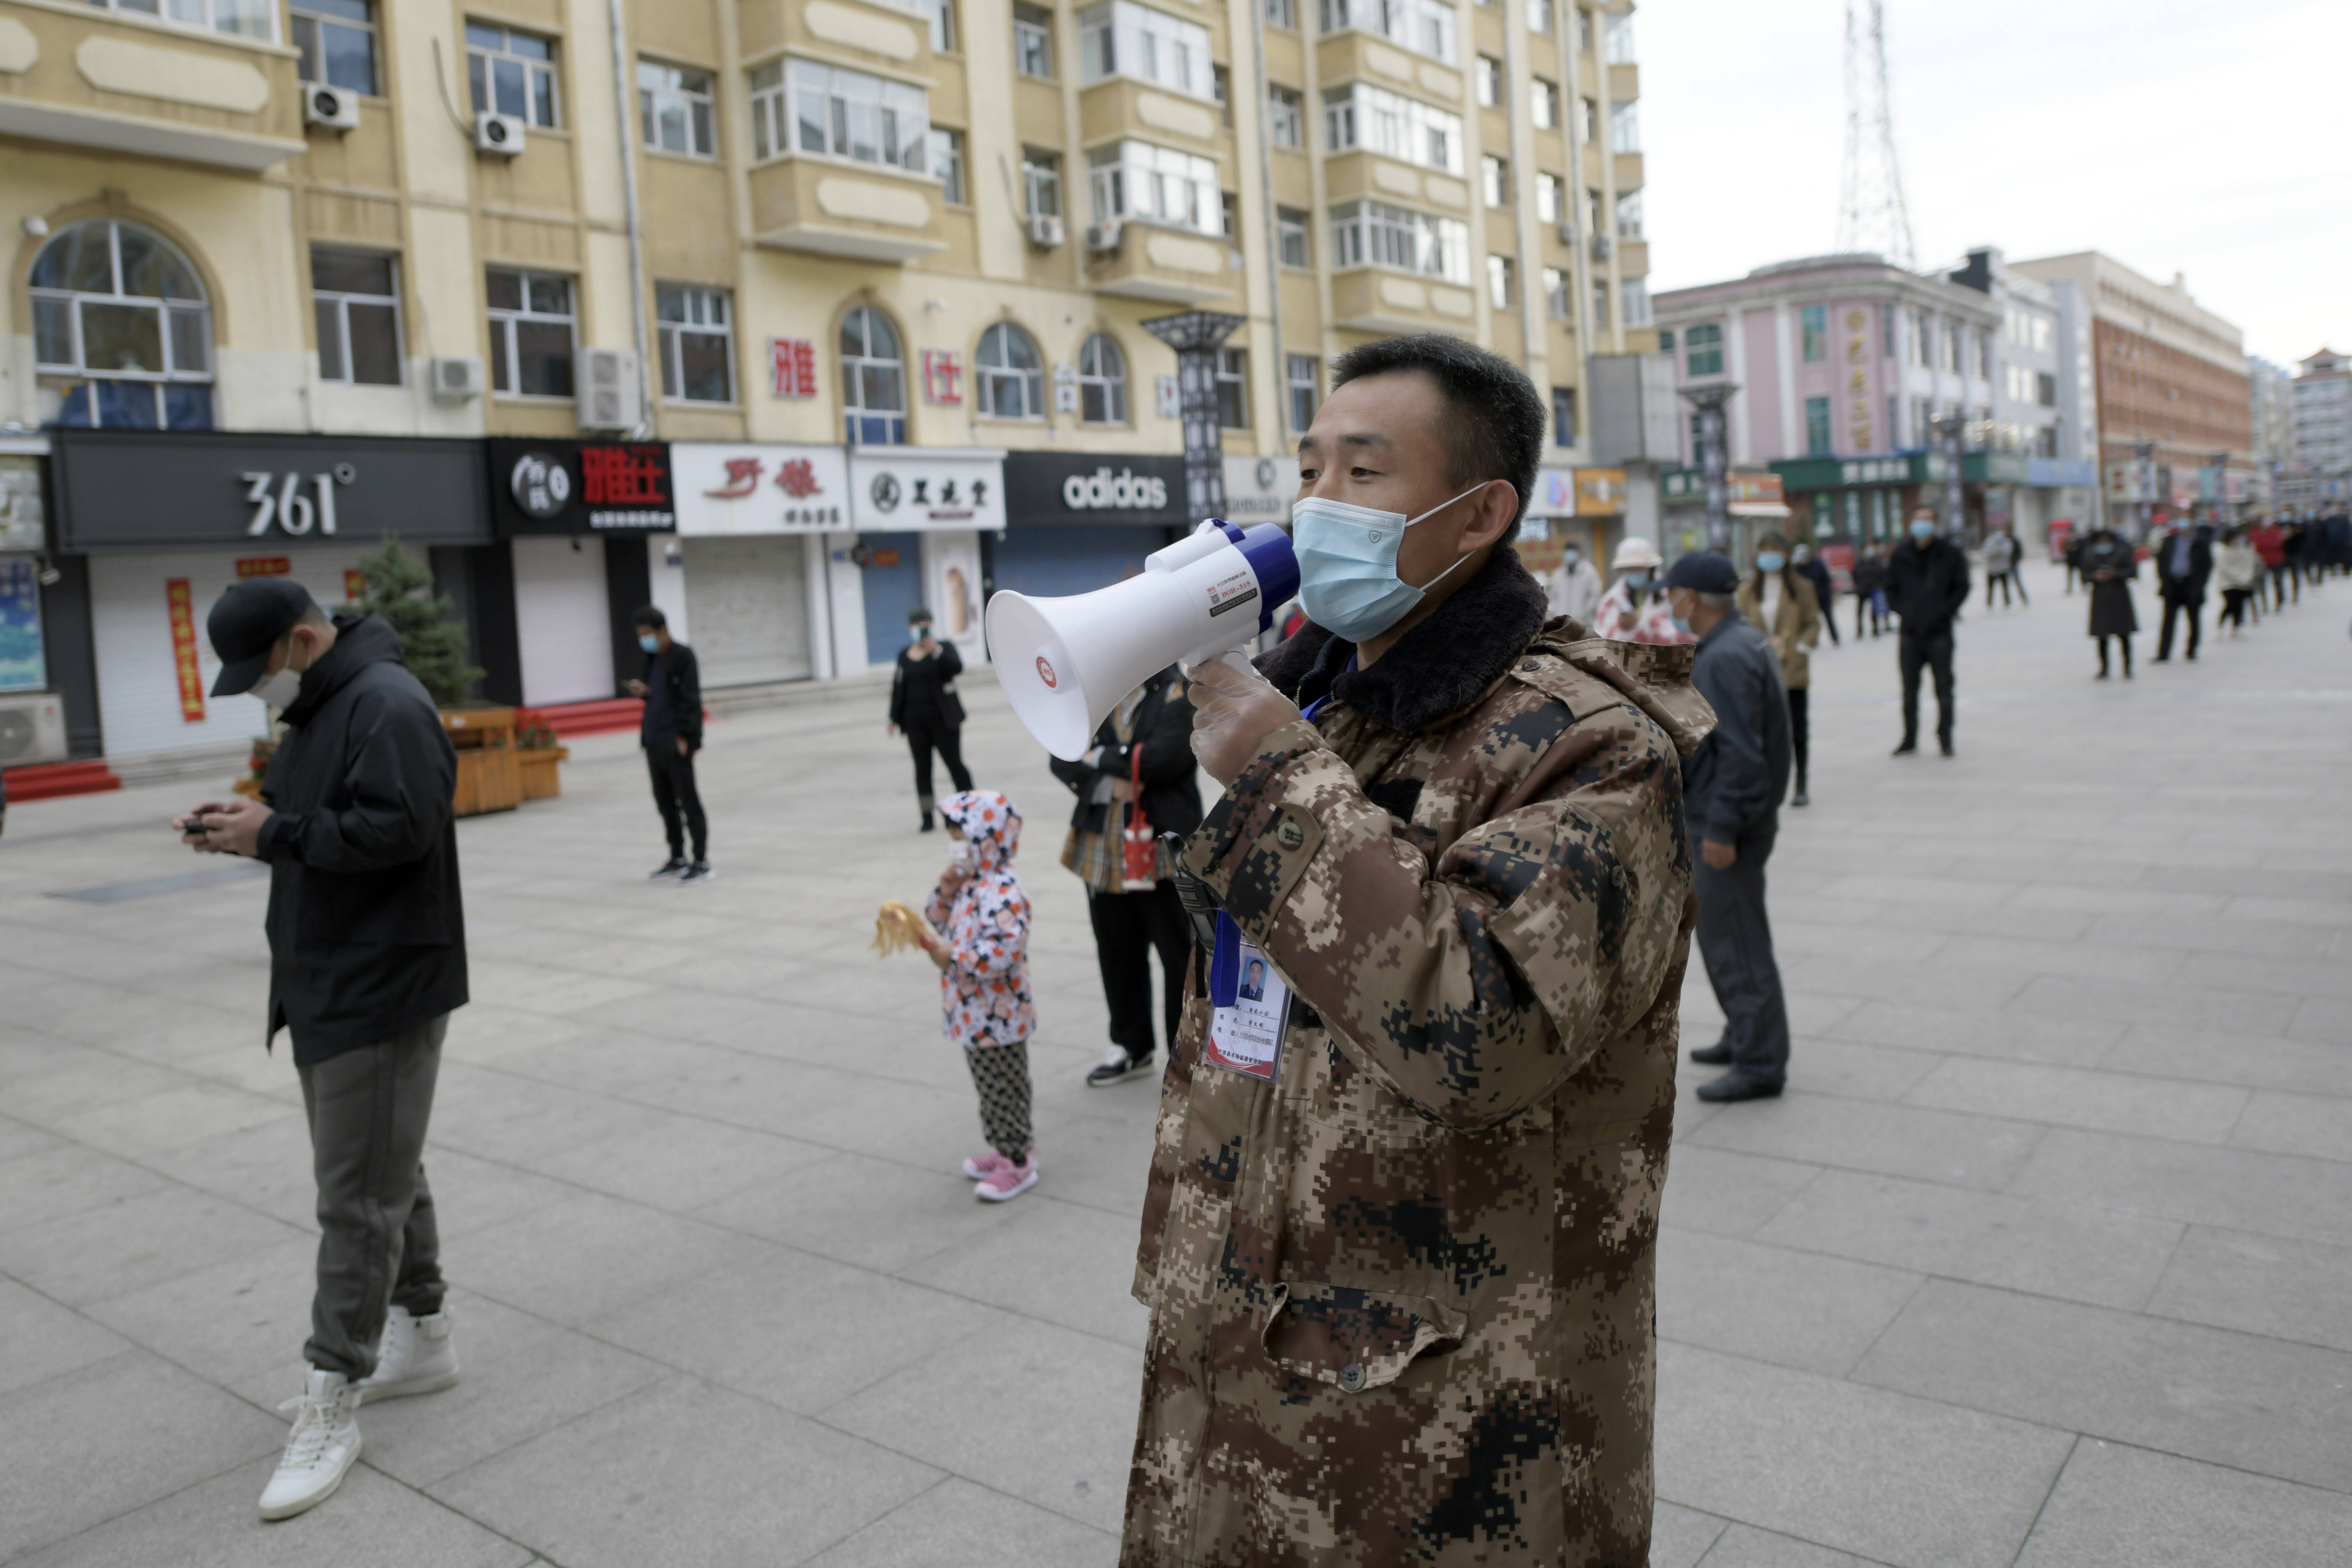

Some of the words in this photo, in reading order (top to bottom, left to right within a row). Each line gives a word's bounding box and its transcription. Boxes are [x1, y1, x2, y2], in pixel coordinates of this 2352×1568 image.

[773, 338, 818, 396] 雅
[923, 351, 962, 405] 仕
[1063, 467, 1168, 510] adidas
[1221, 580, 1251, 598] BOH-518
